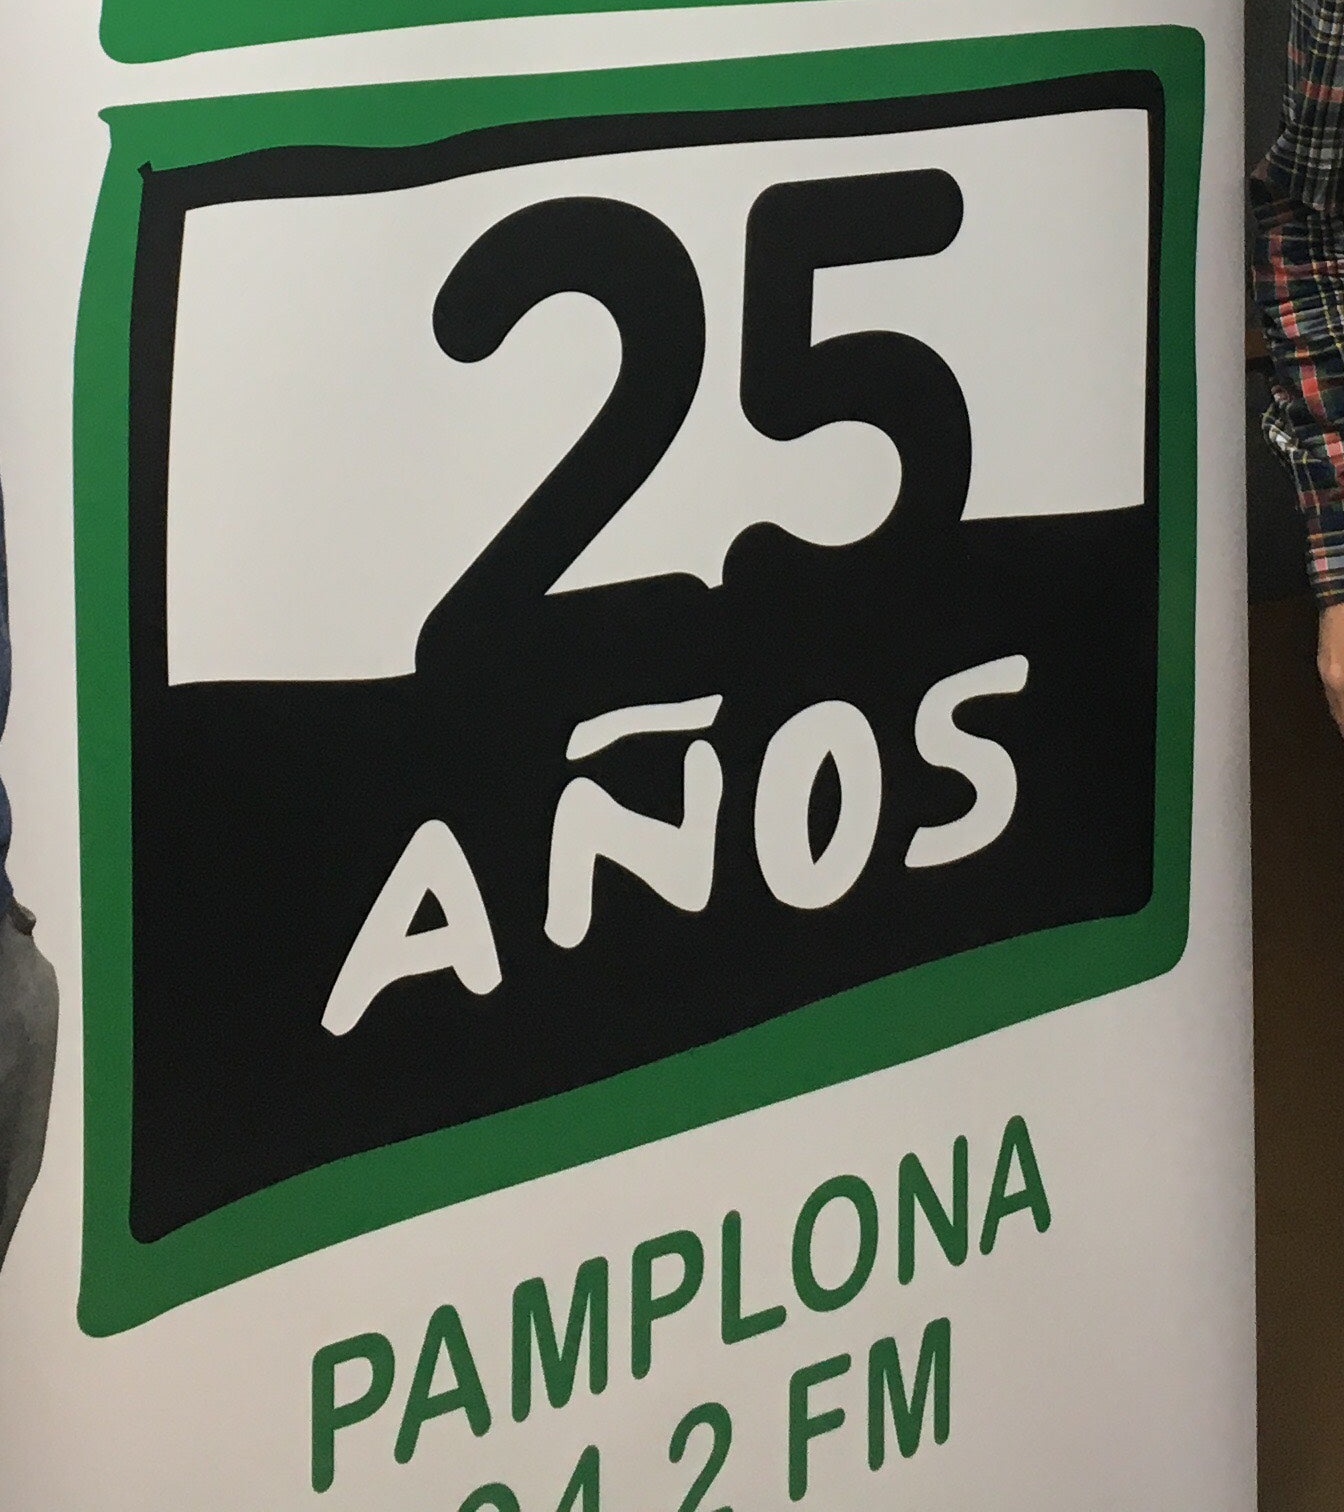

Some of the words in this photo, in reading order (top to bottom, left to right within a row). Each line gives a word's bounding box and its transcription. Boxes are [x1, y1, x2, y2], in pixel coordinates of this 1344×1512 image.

[415, 168, 972, 676] 25
[321, 654, 1030, 1036] AÑOS
[311, 1115, 1052, 1494] PAMPLONA
[788, 1317, 951, 1502] FM
